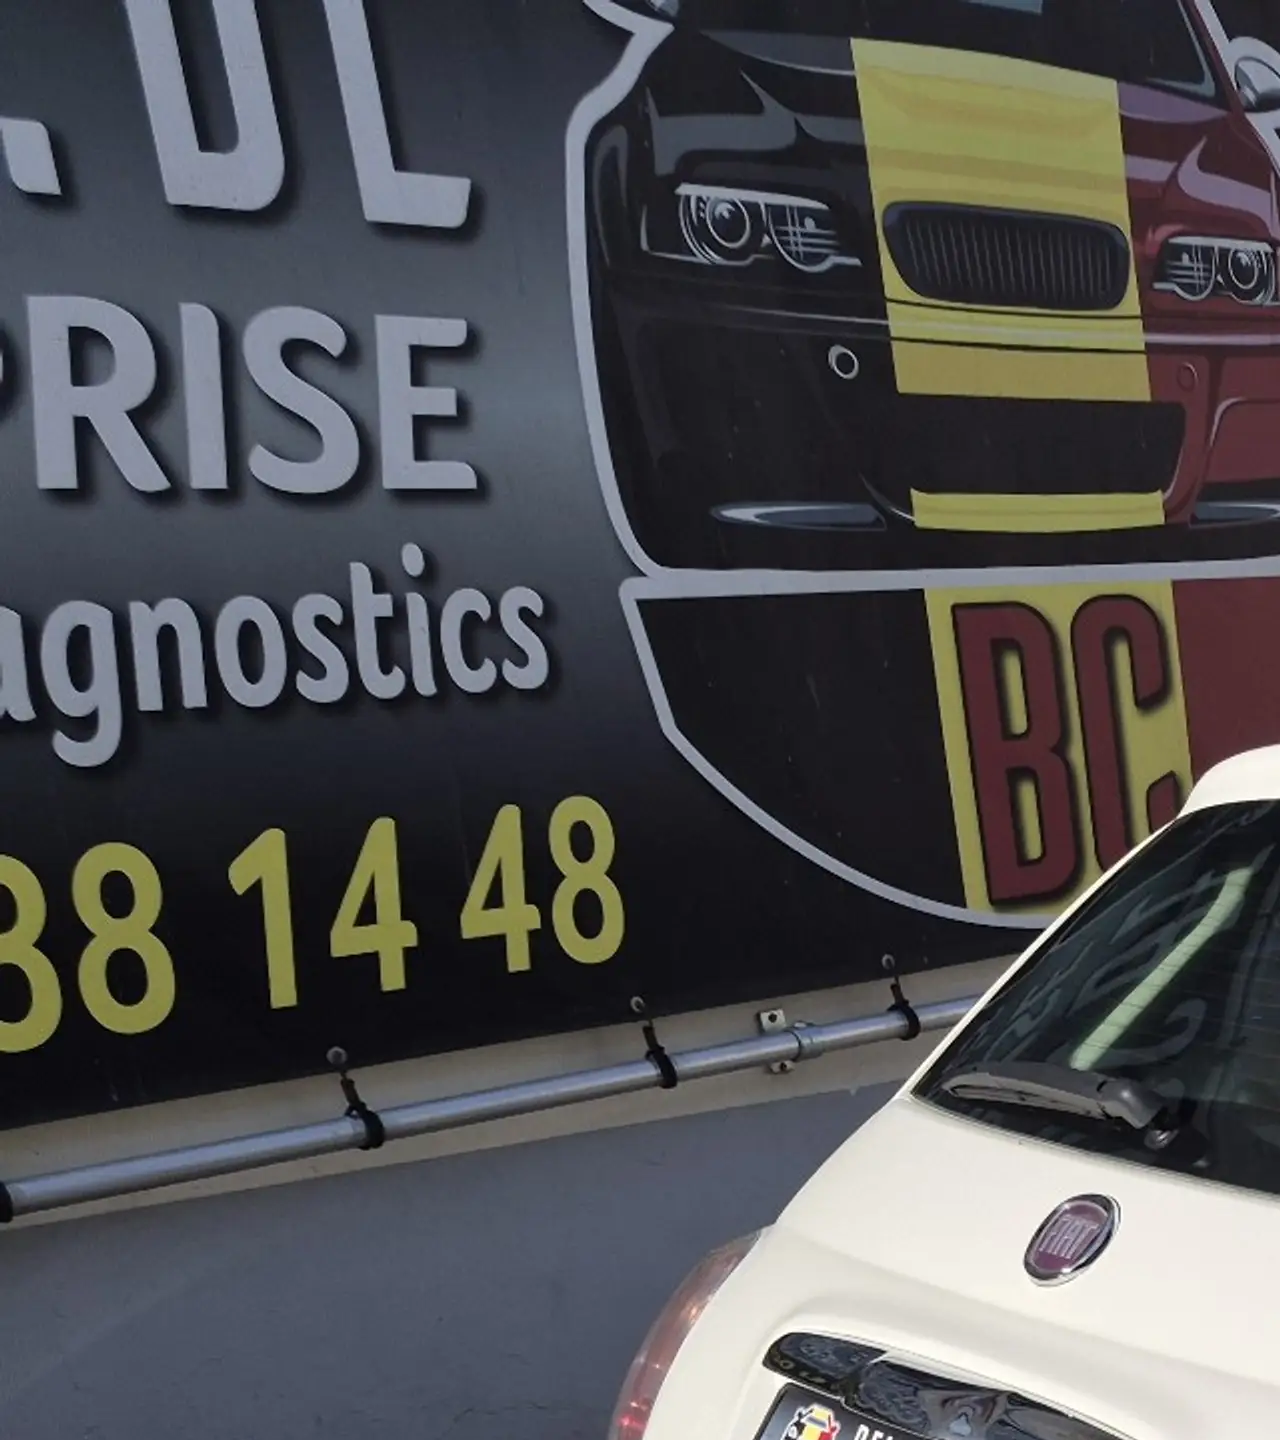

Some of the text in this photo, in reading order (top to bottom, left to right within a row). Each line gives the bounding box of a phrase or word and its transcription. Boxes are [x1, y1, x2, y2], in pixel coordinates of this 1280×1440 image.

[0, 296, 478, 494] RISE
[952, 594, 1183, 906] BC
[228, 817, 418, 1009] 14
[460, 796, 625, 972] 48
[1037, 1212, 1100, 1260] FIAT
